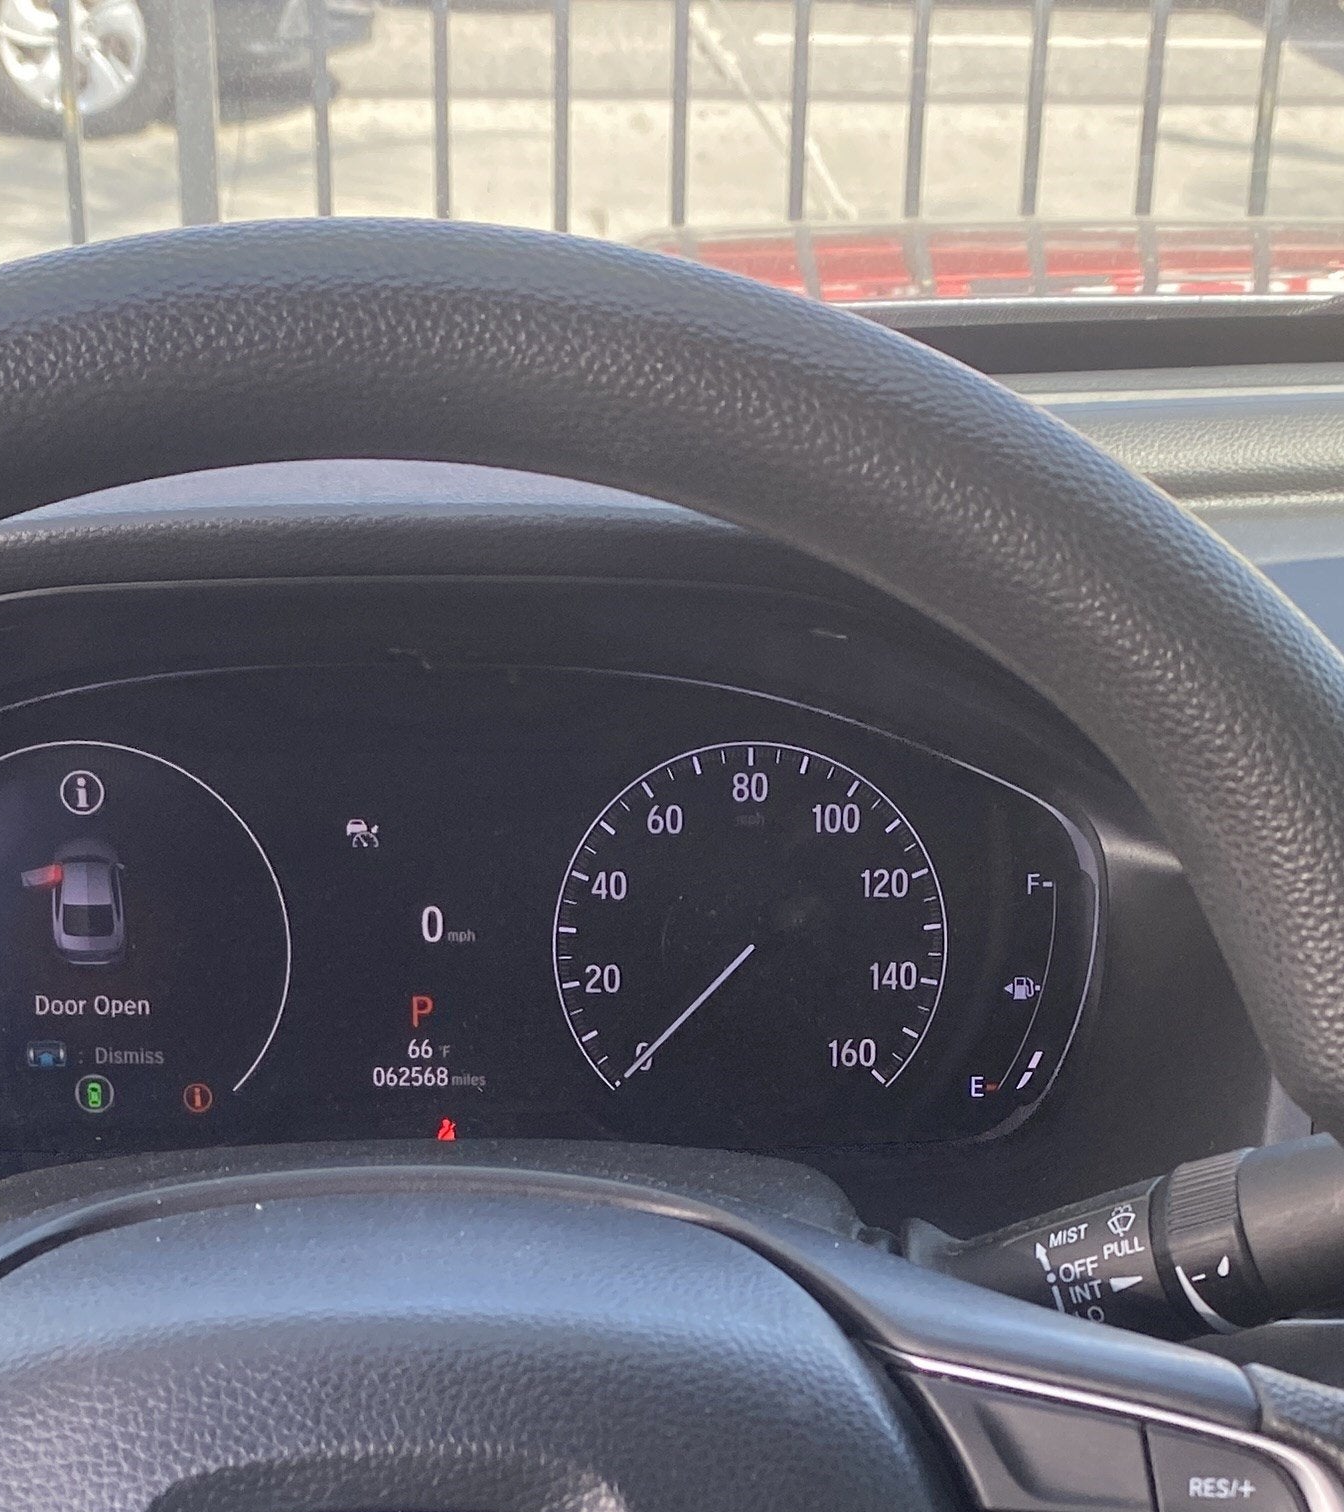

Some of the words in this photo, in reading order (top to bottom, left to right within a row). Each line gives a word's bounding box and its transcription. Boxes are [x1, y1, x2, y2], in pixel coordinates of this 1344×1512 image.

[732, 772, 769, 803] 80
[646, 803, 684, 835] 60
[812, 803, 861, 834] 100
[591, 871, 628, 900] 40
[861, 868, 909, 898] 120
[1027, 874, 1040, 894] F
[421, 906, 444, 943] 0
[447, 929, 476, 943] mph
[585, 964, 621, 993] 20
[869, 961, 918, 991] 140
[35, 995, 86, 1017] Door
[94, 995, 150, 1019] Open
[412, 996, 434, 1028] P
[95, 1046, 165, 1065] Dismiss
[408, 1039, 433, 1059] 66
[828, 1038, 877, 1067] 160
[373, 1067, 449, 1087] 062568
[452, 1074, 487, 1087] miles
[971, 1078, 985, 1098] E
[1049, 1223, 1088, 1248] MIST
[1103, 1236, 1145, 1260] PULL
[1059, 1256, 1099, 1283] OFF
[1069, 1279, 1102, 1304] INT
